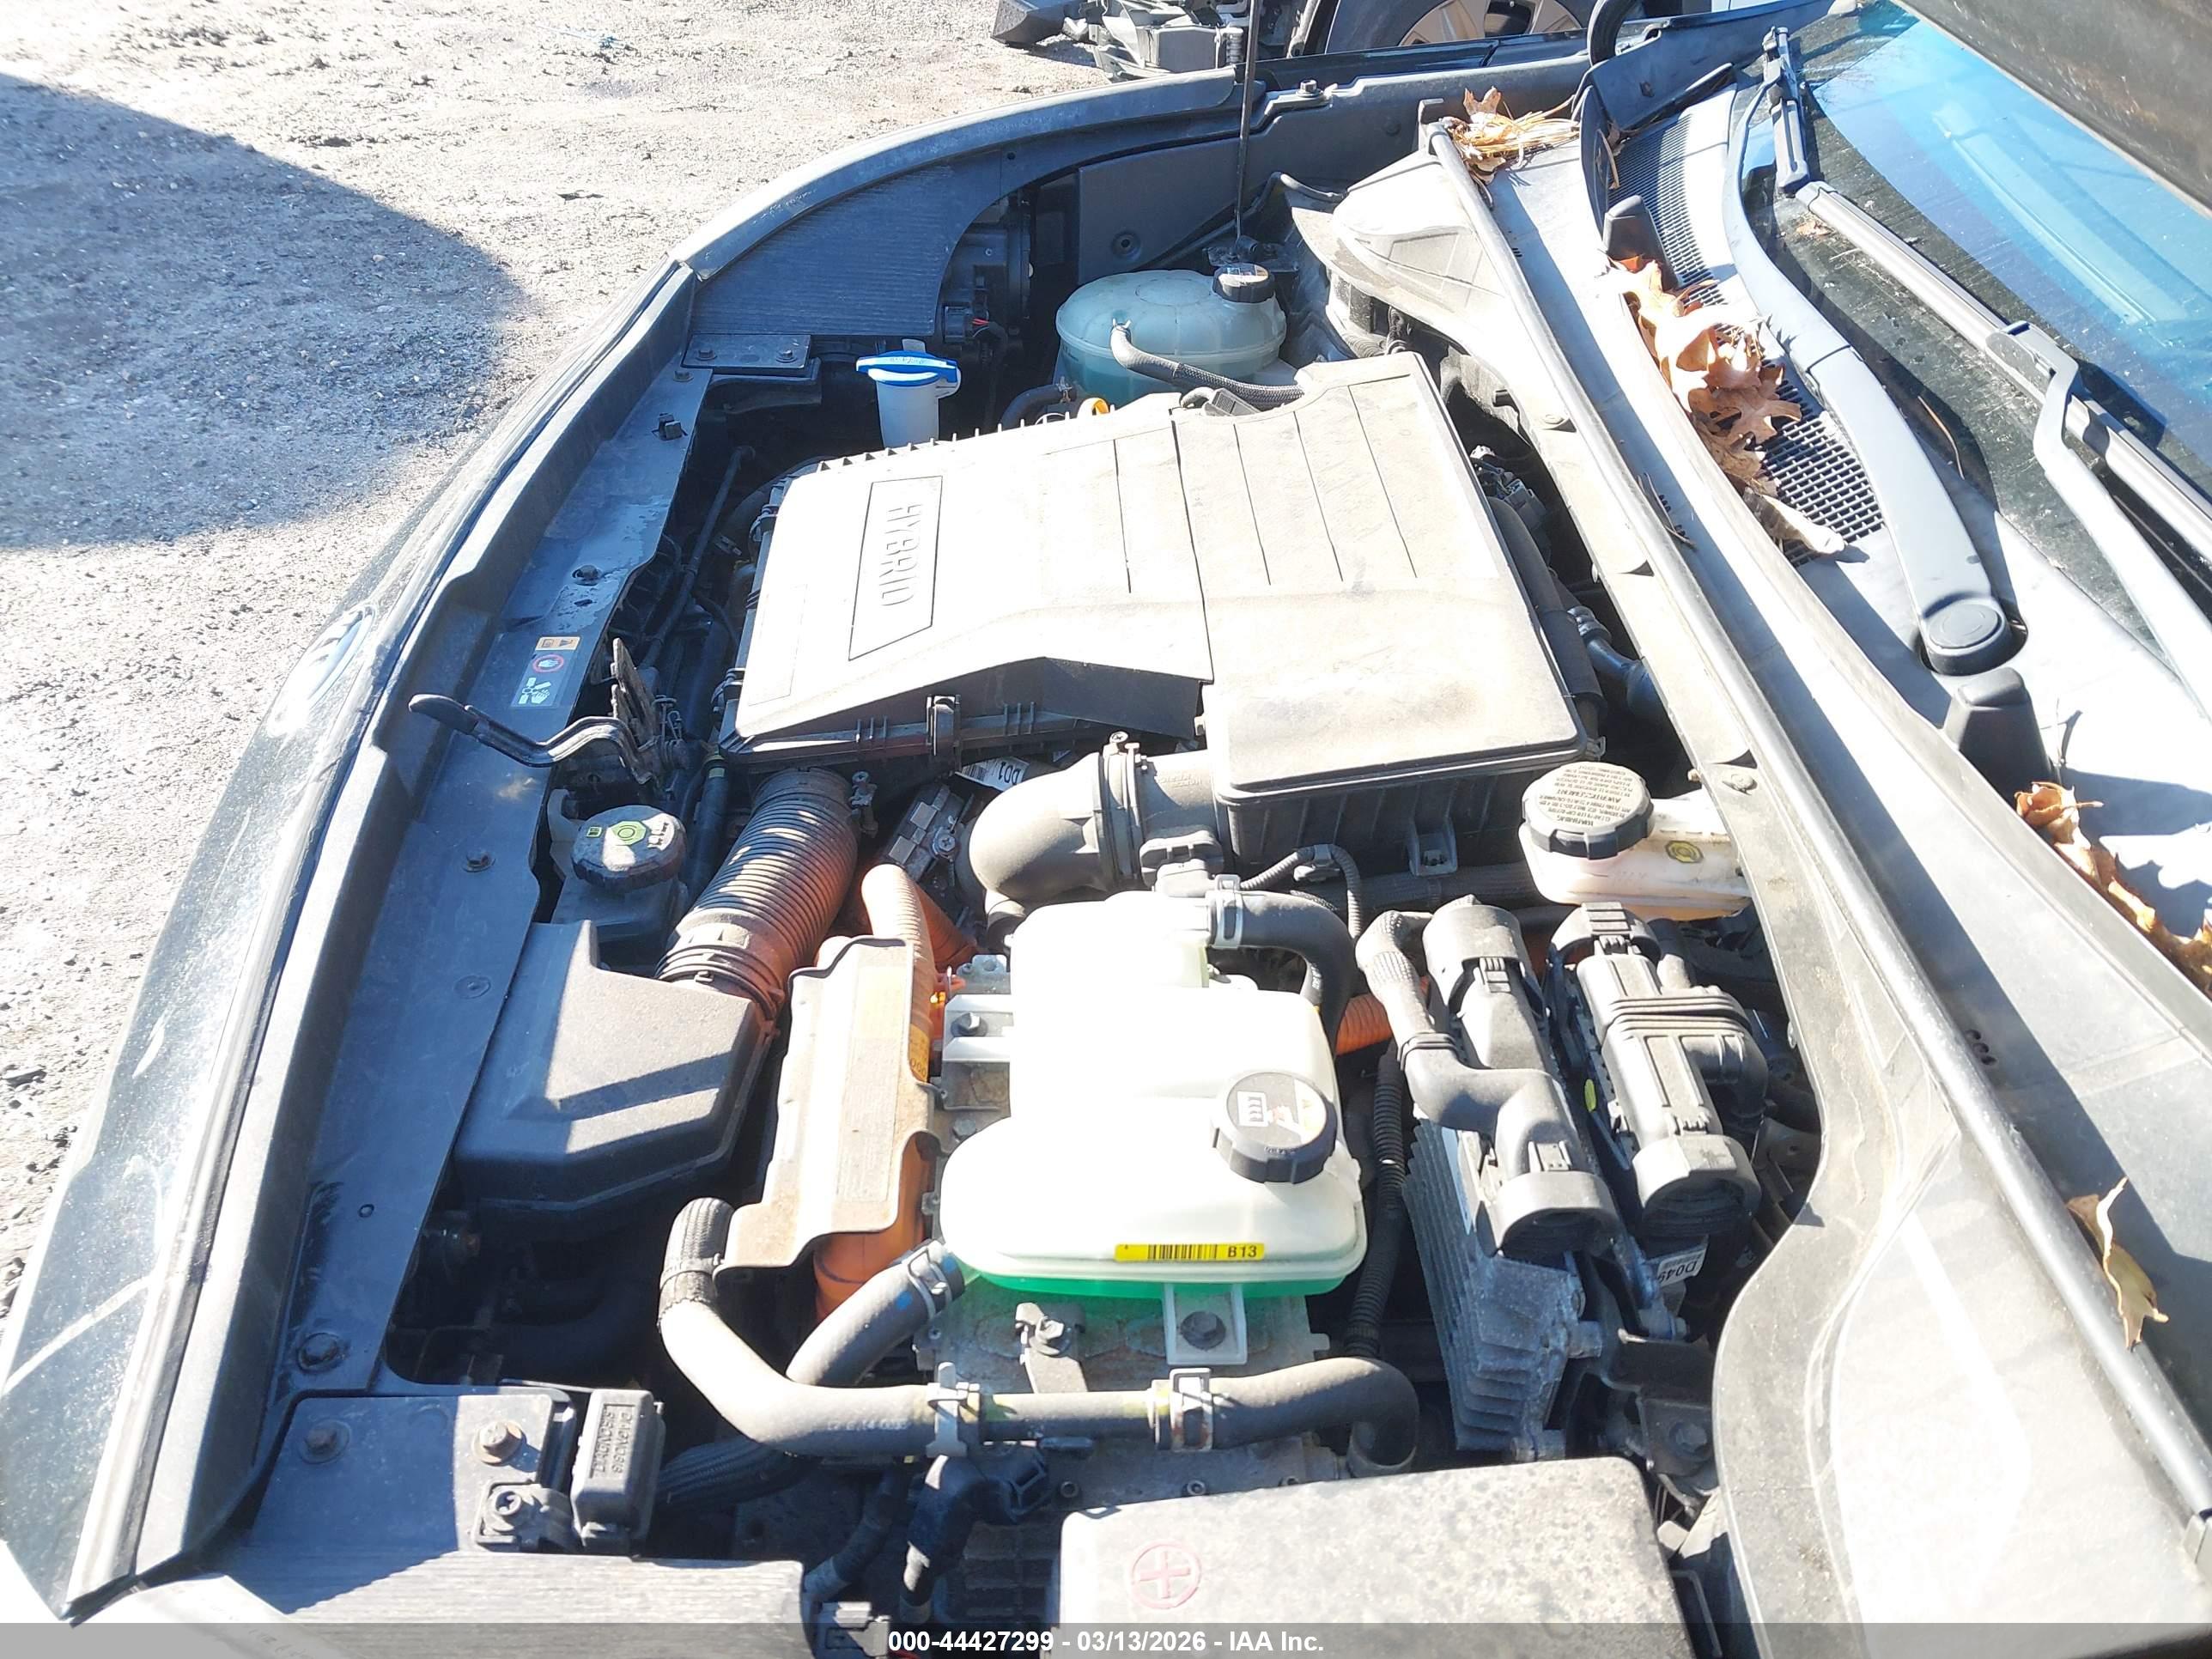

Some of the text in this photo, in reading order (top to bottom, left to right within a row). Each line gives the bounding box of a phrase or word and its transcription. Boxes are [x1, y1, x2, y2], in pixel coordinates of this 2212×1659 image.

[878, 503, 923, 606] HYBRID
[998, 761, 1022, 786] D01
[1227, 1245, 1258, 1258] B13
